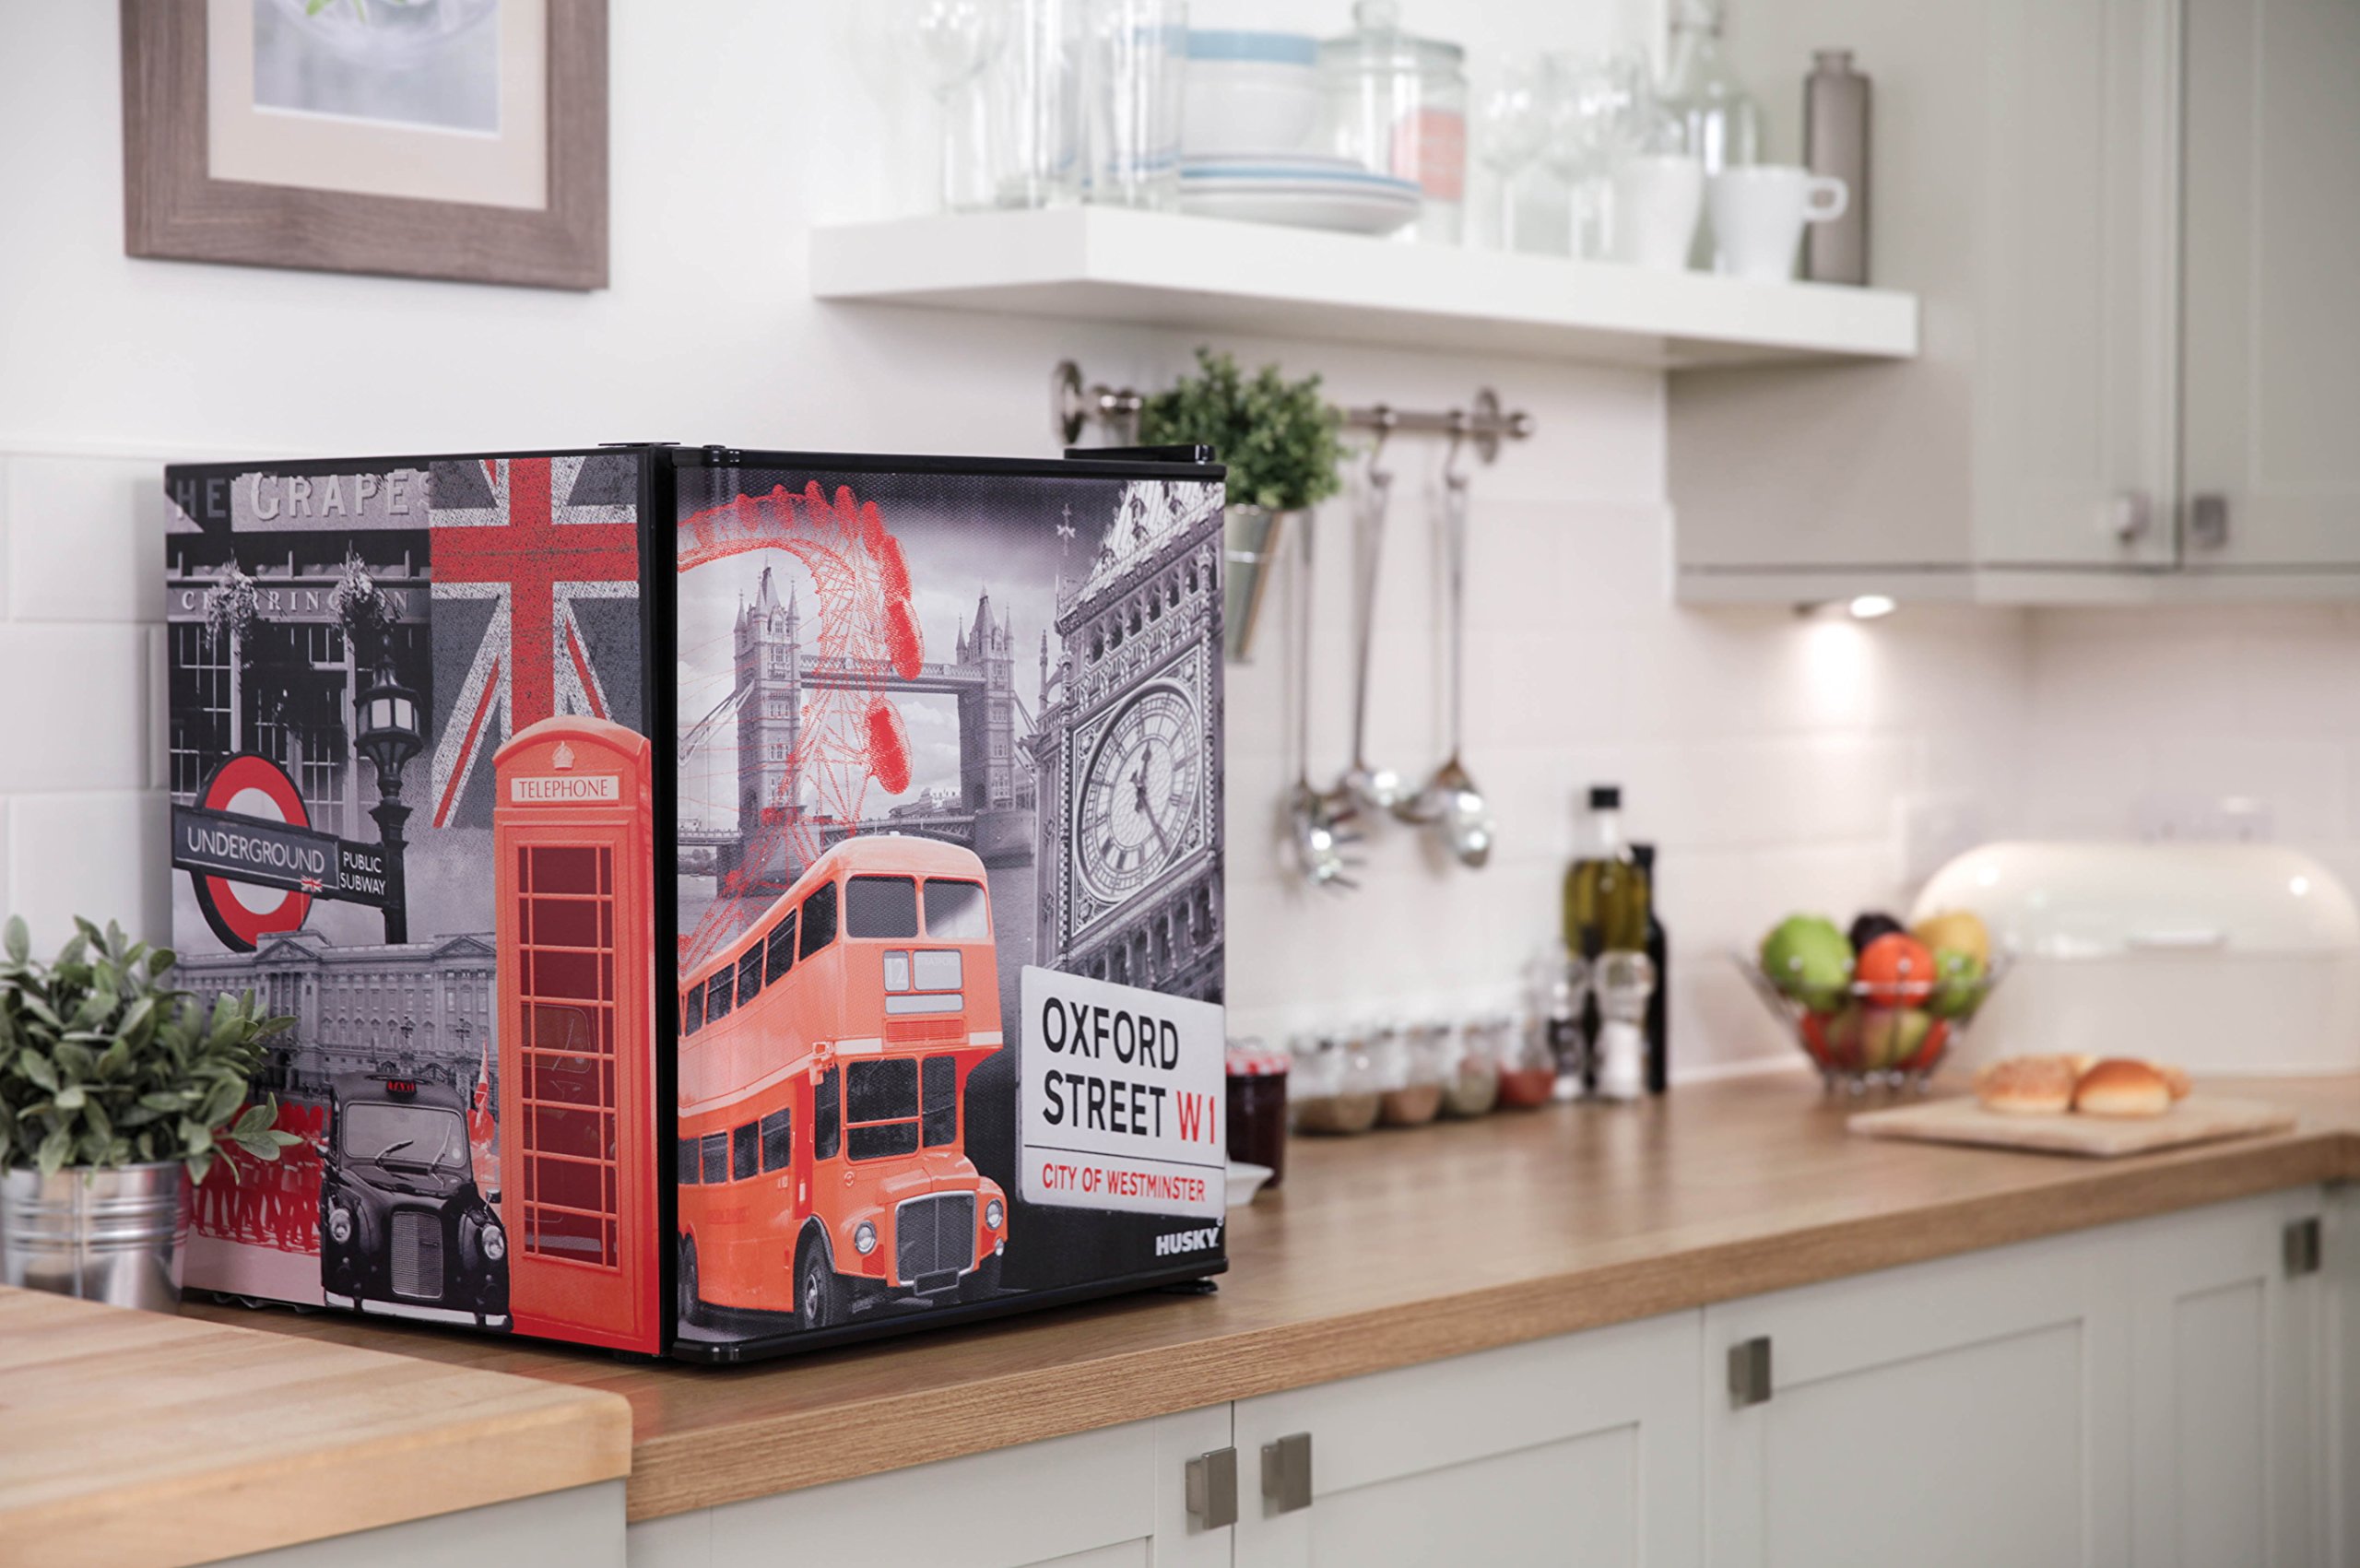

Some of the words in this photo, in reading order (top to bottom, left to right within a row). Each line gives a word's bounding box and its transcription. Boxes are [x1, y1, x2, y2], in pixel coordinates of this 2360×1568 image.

[166, 477, 227, 518] HE
[519, 779, 608, 798] TELEPHONE
[187, 826, 324, 874] UNDERGROUND
[343, 851, 382, 873] PUBLIC
[339, 872, 386, 896] SUBWAY
[1042, 996, 1179, 1070] OXFORD
[1042, 1069, 1166, 1138] STREET
[1176, 1090, 1215, 1144] W1
[1042, 1162, 1077, 1192] CITY
[1081, 1167, 1103, 1193] OF
[1106, 1171, 1206, 1202] WESTMINSTER
[1155, 1226, 1220, 1256] HUSKY
